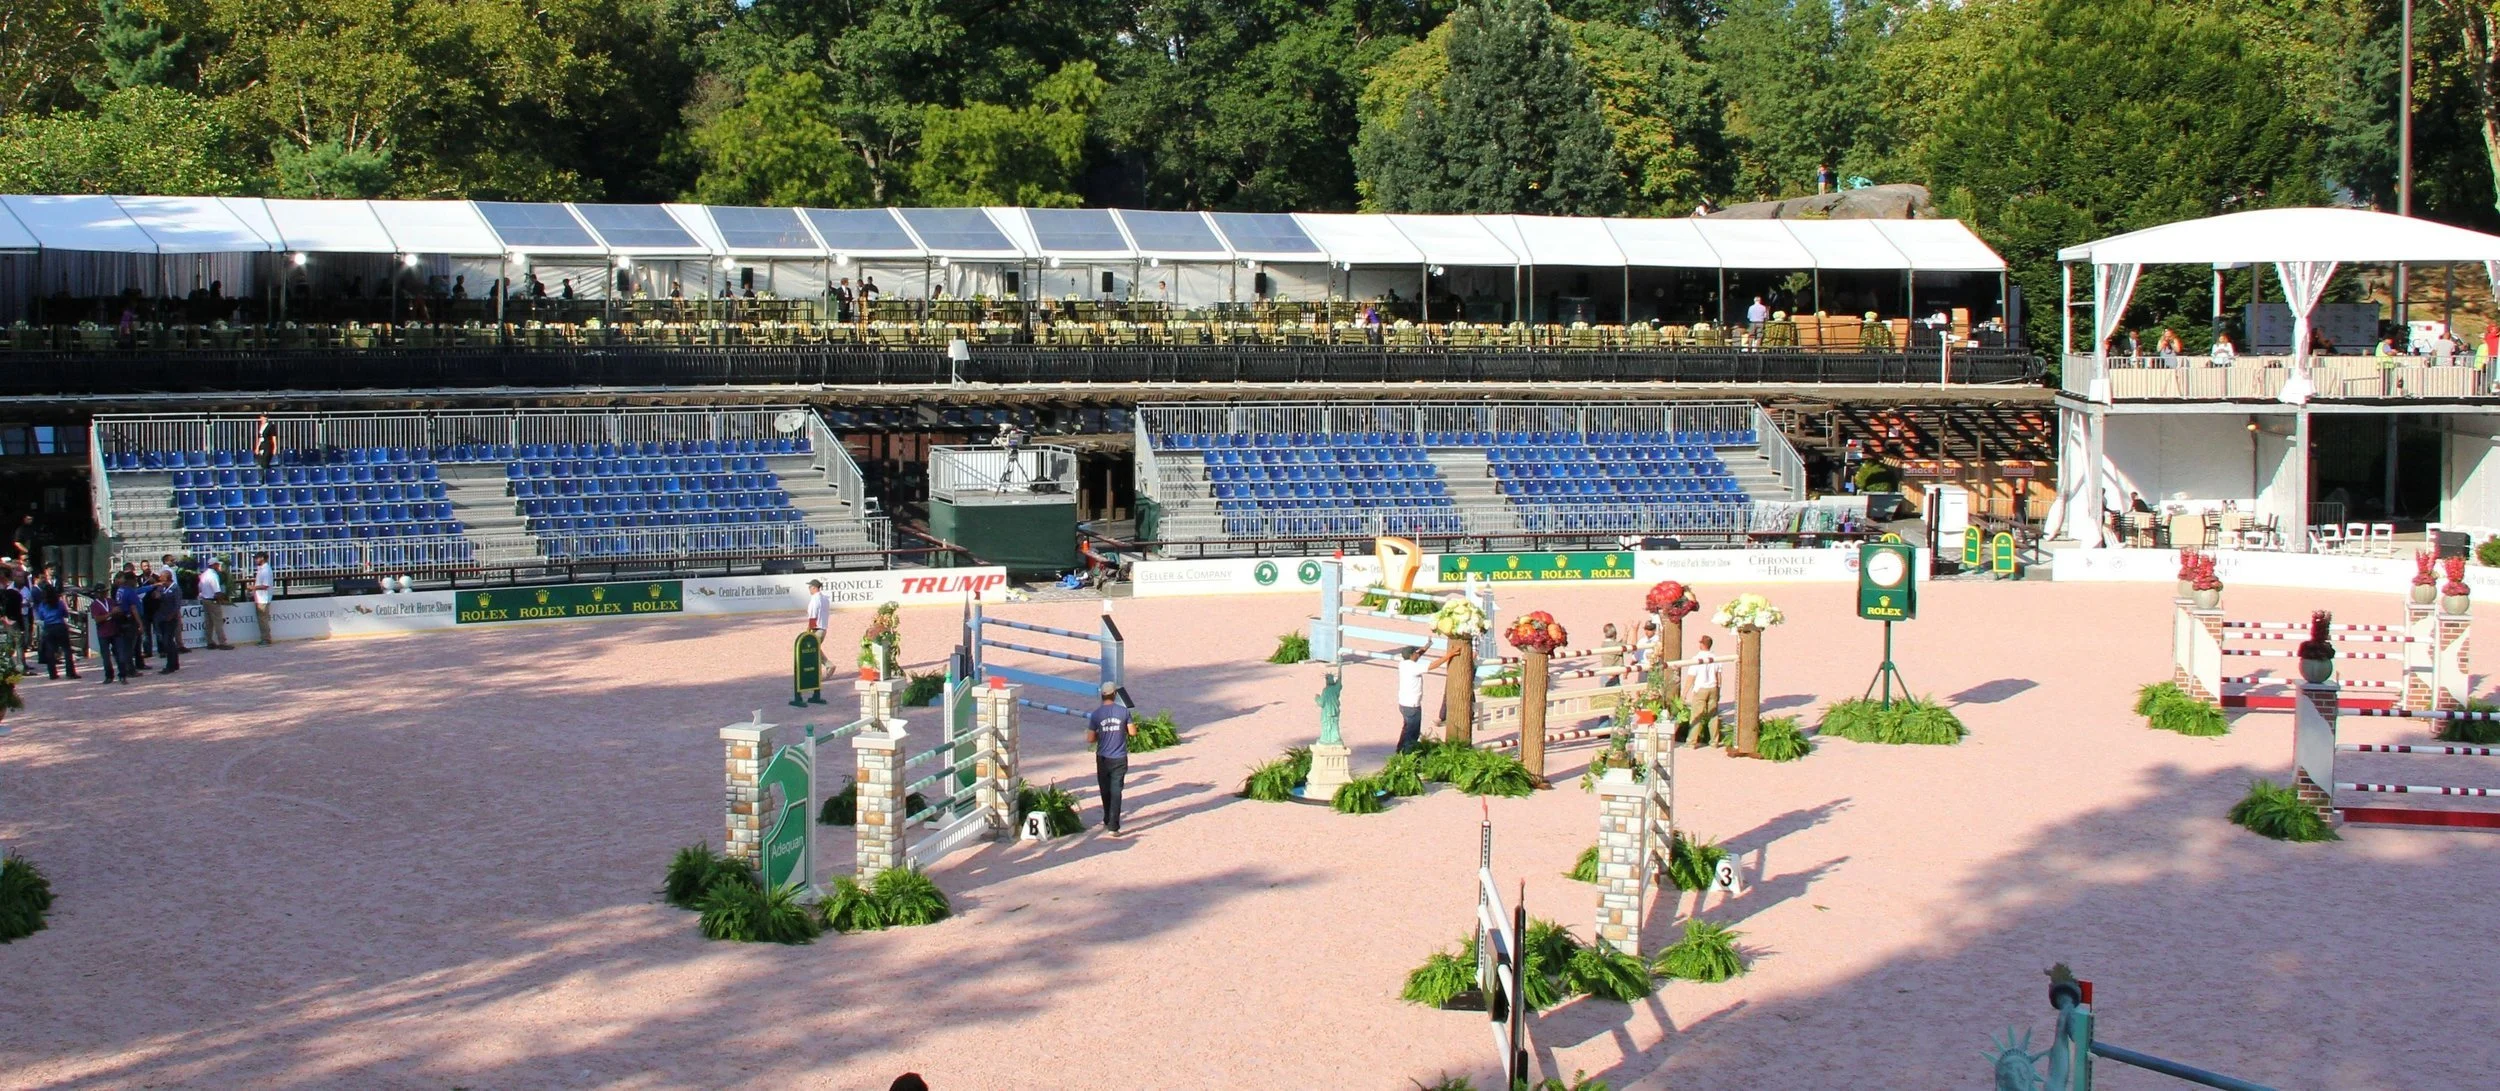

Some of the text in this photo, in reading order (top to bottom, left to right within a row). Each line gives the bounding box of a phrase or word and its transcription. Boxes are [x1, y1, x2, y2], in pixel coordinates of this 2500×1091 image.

[1749, 555, 1815, 565] CHRONICLE
[1140, 570, 1174, 581] GELLER
[1186, 568, 1232, 580] COMPANY
[1442, 568, 1631, 581] ROLX ROLEX ROLEX ROLEX
[1767, 565, 1808, 576] HORSE
[821, 579, 883, 591] HRONICLE
[901, 574, 1005, 594] TRUMP
[719, 586, 740, 598] Central
[741, 585, 755, 597] Park
[756, 585, 774, 596] Horse
[775, 584, 791, 595] Show
[831, 591, 874, 602] HORSE
[182, 606, 204, 618] ACH
[376, 601, 452, 616] Central Park Horse Show
[461, 608, 509, 621] ROLEX
[519, 605, 566, 618] ROLEX
[575, 602, 622, 615] ROLEX
[632, 600, 678, 612] ROLEX
[1867, 607, 1902, 616] ROLEX
[232, 610, 335, 624] AXEL HNSON GROUP
[1030, 818, 1039, 836] B
[772, 835, 804, 859] Adequan
[1720, 867, 1732, 887] 3
